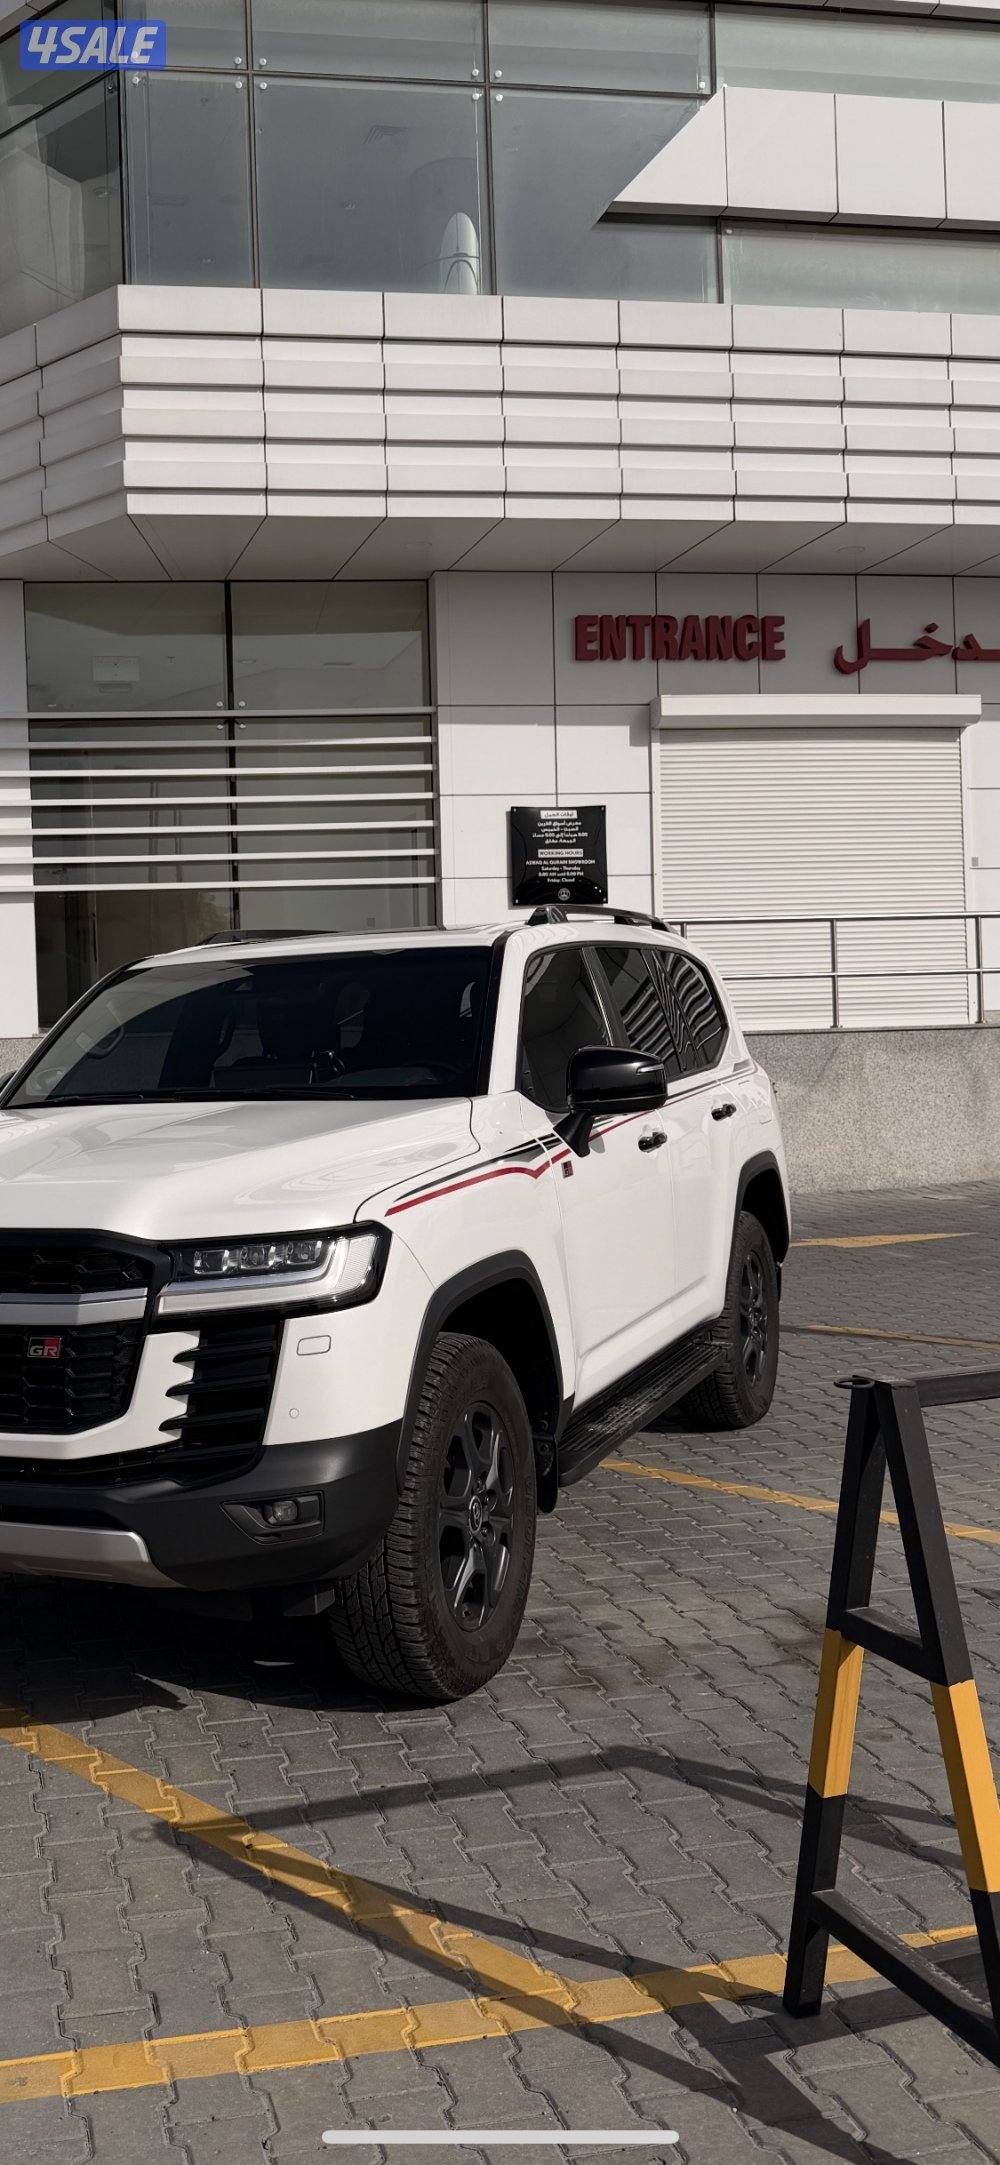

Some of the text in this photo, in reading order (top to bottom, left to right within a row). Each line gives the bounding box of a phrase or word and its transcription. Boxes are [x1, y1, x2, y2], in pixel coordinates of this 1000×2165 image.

[574, 614, 786, 662] ENTRANCE
[834, 619, 1000, 675] دخل
[29, 1345, 58, 1357] GR
